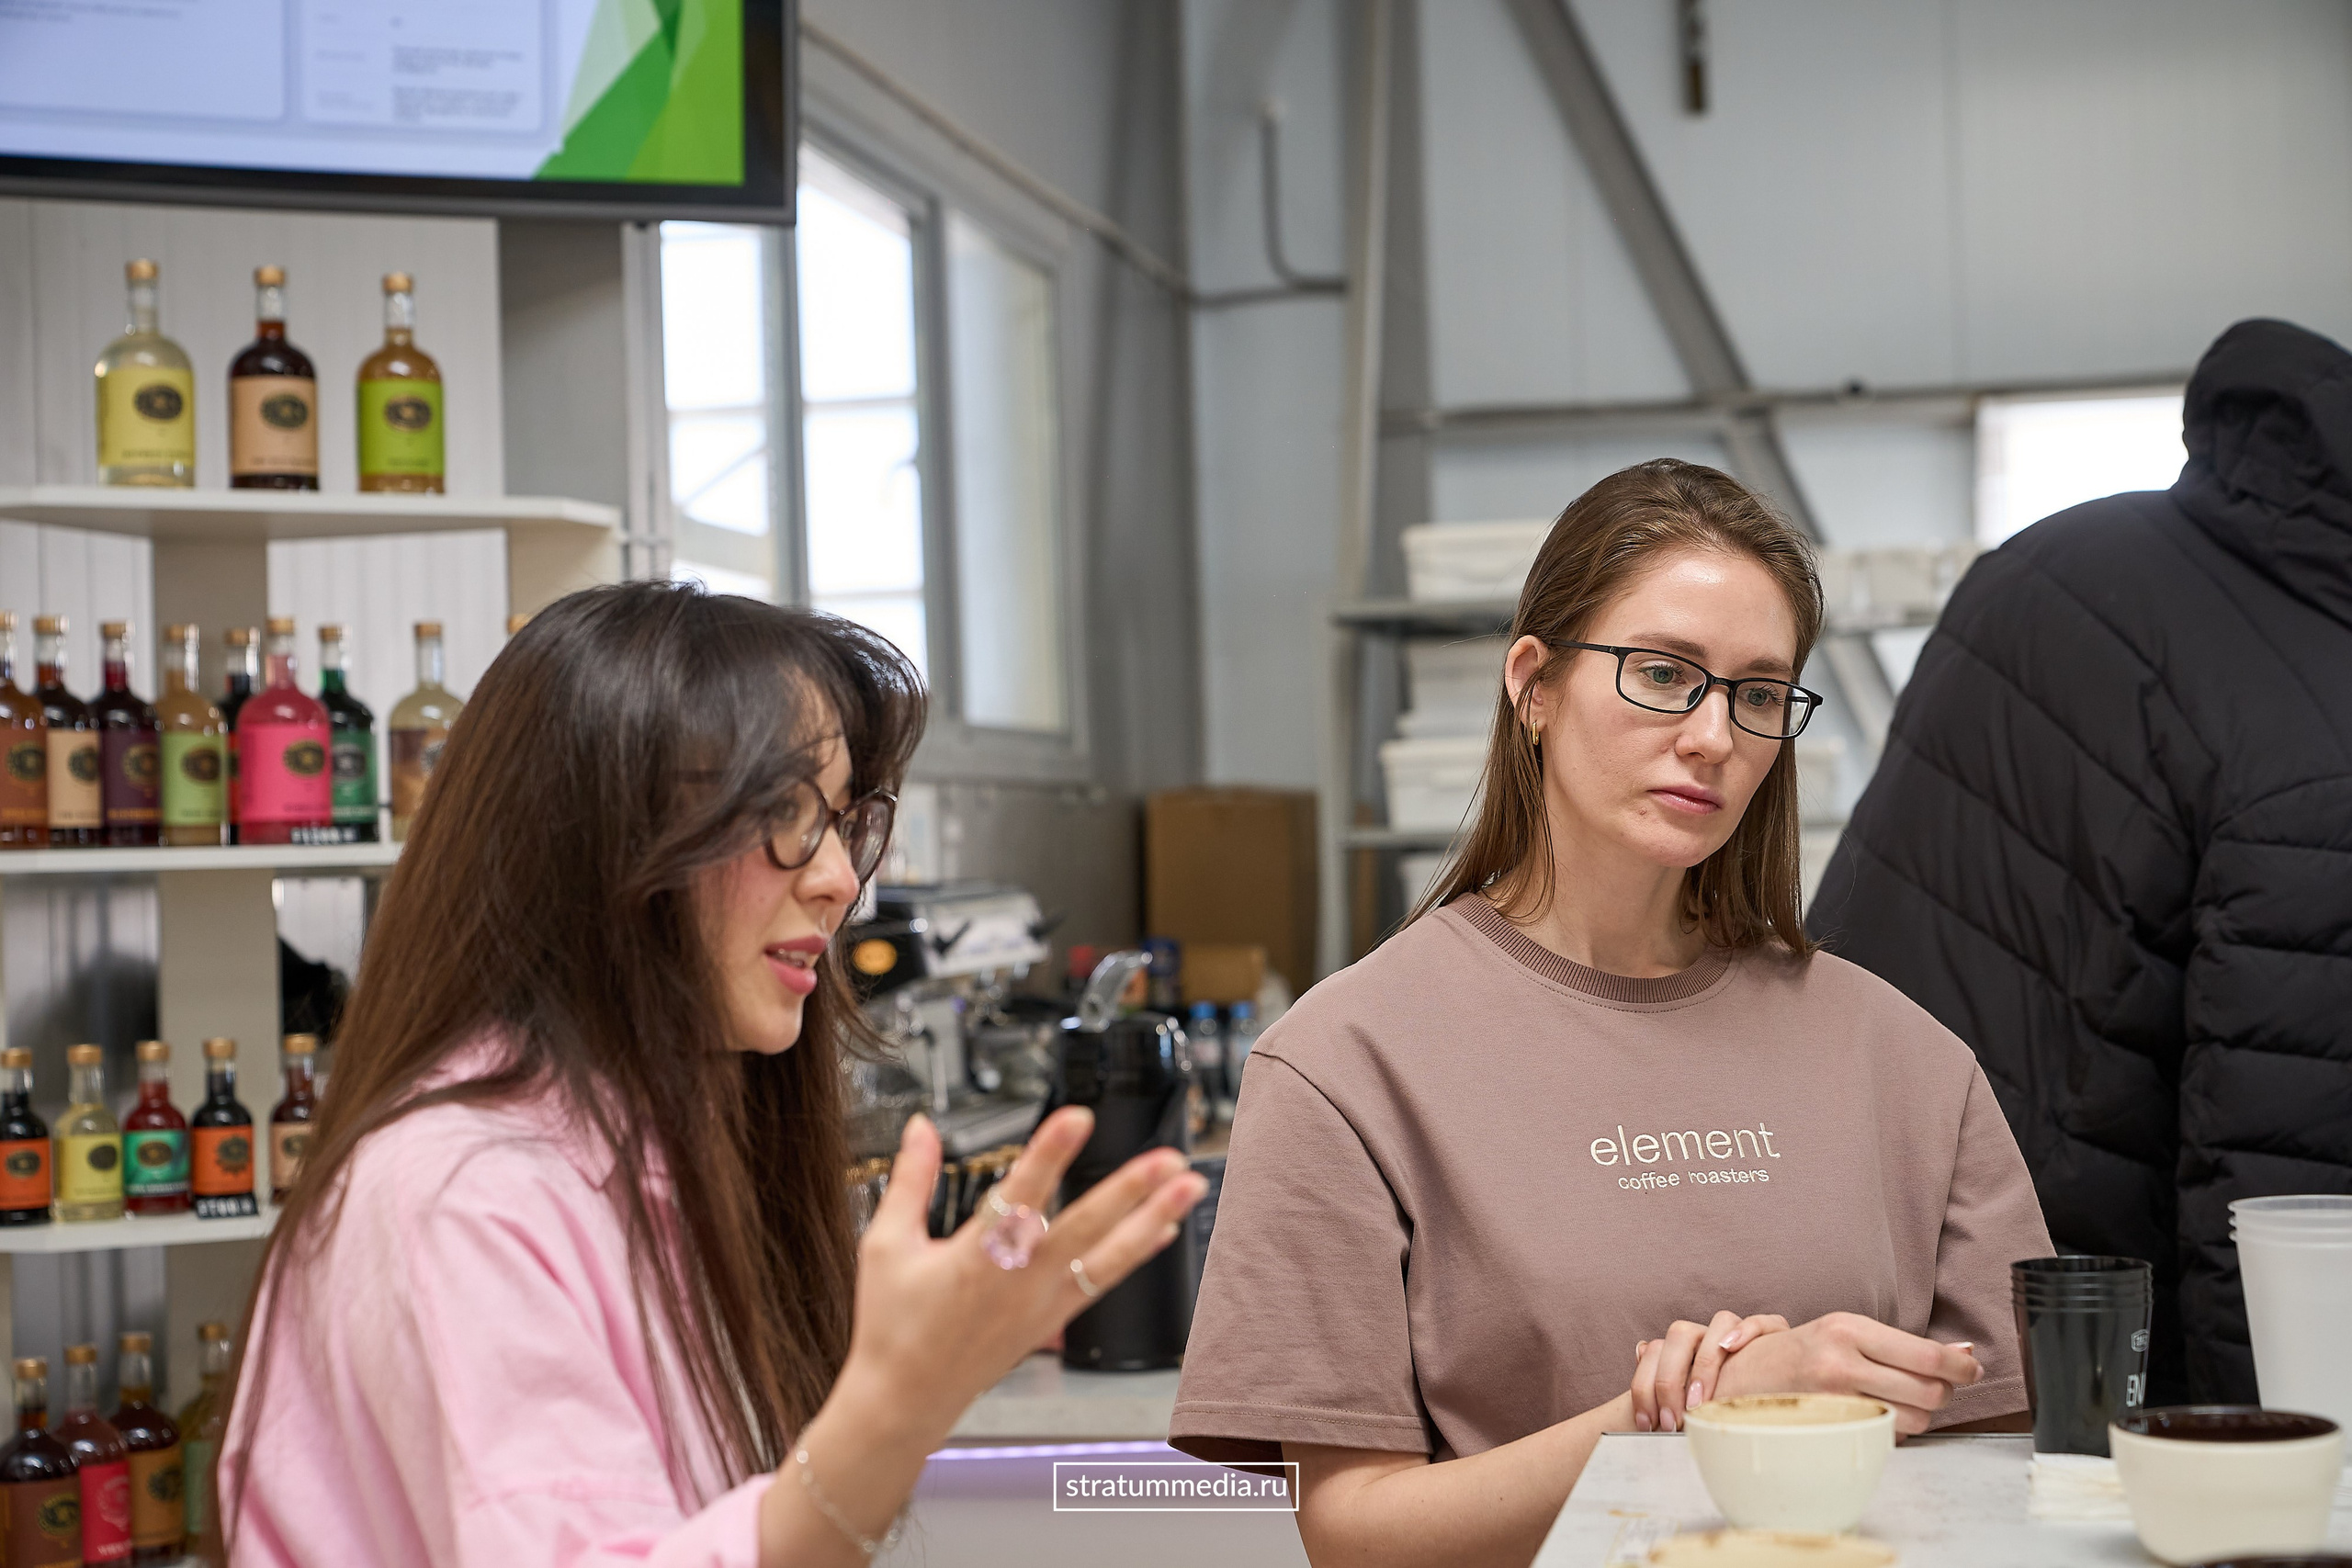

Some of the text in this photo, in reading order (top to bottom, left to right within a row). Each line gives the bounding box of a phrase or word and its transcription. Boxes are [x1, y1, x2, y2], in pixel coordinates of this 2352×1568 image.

[1589, 1122, 1781, 1166] element
[1618, 1168, 1770, 1190] coffee roasters
